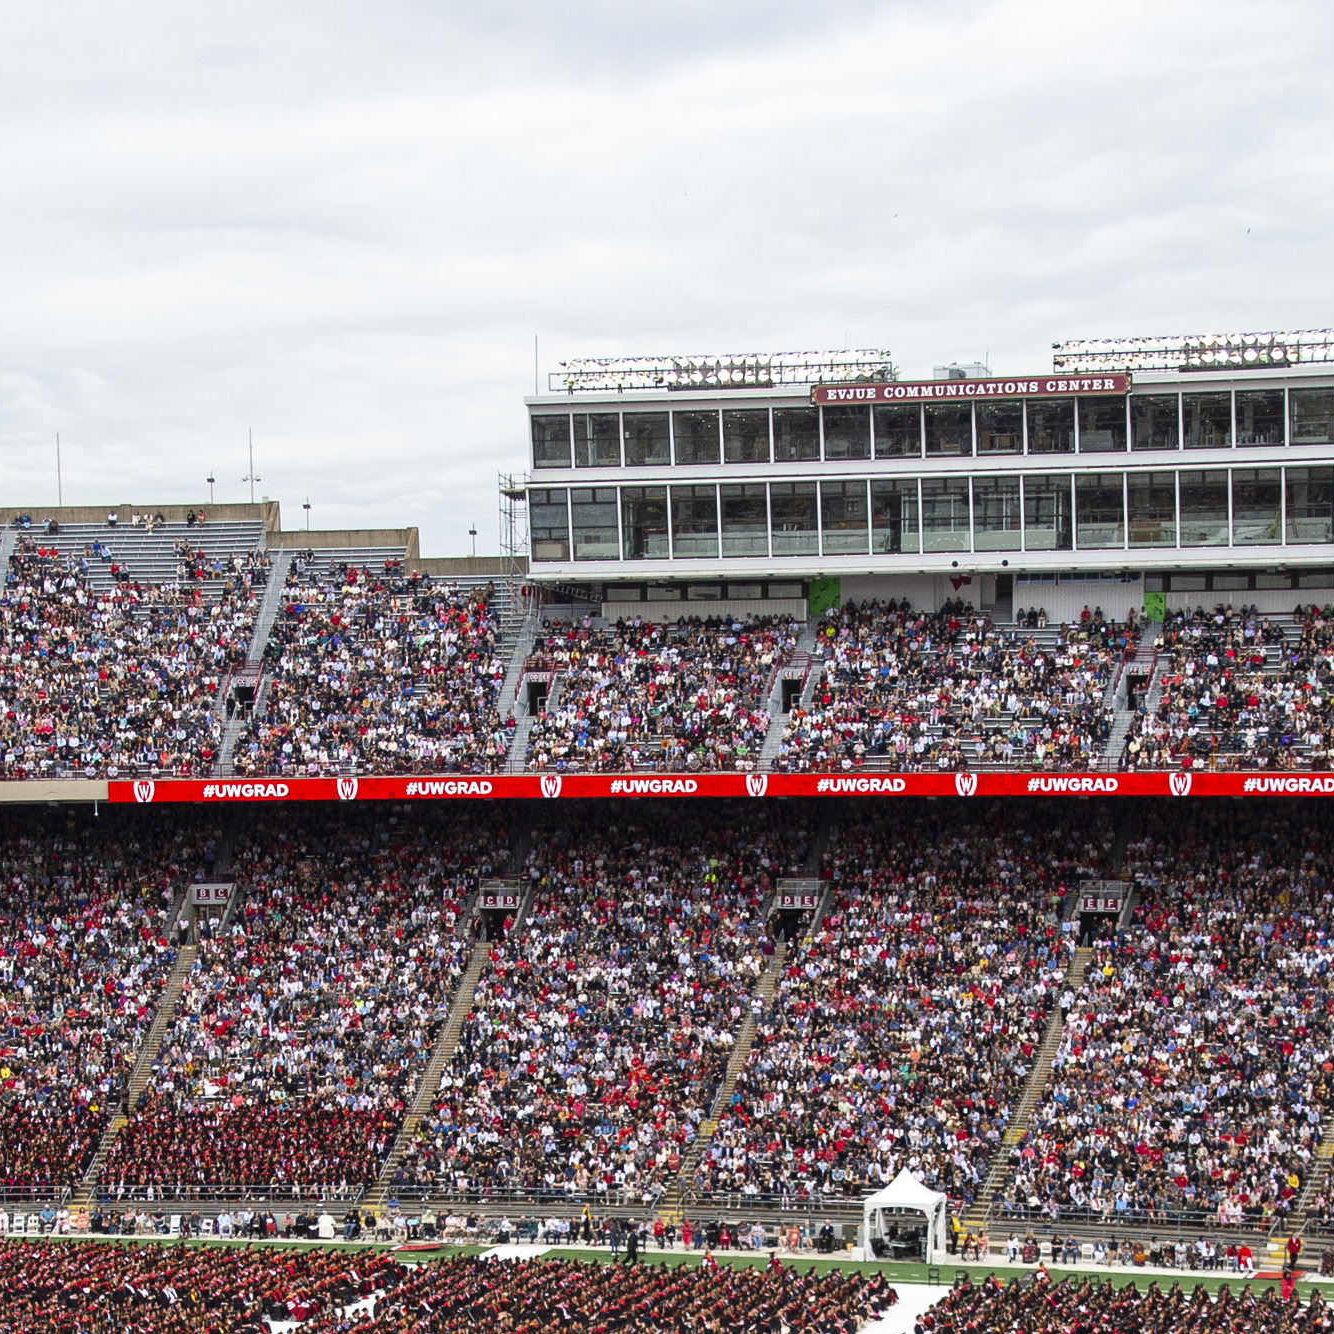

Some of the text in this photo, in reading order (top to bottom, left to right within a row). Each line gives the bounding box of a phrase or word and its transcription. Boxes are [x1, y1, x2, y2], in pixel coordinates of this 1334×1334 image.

[827, 378, 1115, 401] EVJUE COMMUNICATIONS CENTER
[202, 783, 290, 798] #UWGRAD
[405, 781, 493, 796] #UWGRAD
[610, 779, 698, 794] #UWGRAD
[816, 778, 906, 793] #UWGRAD
[1027, 777, 1118, 792] #UWGRAD
